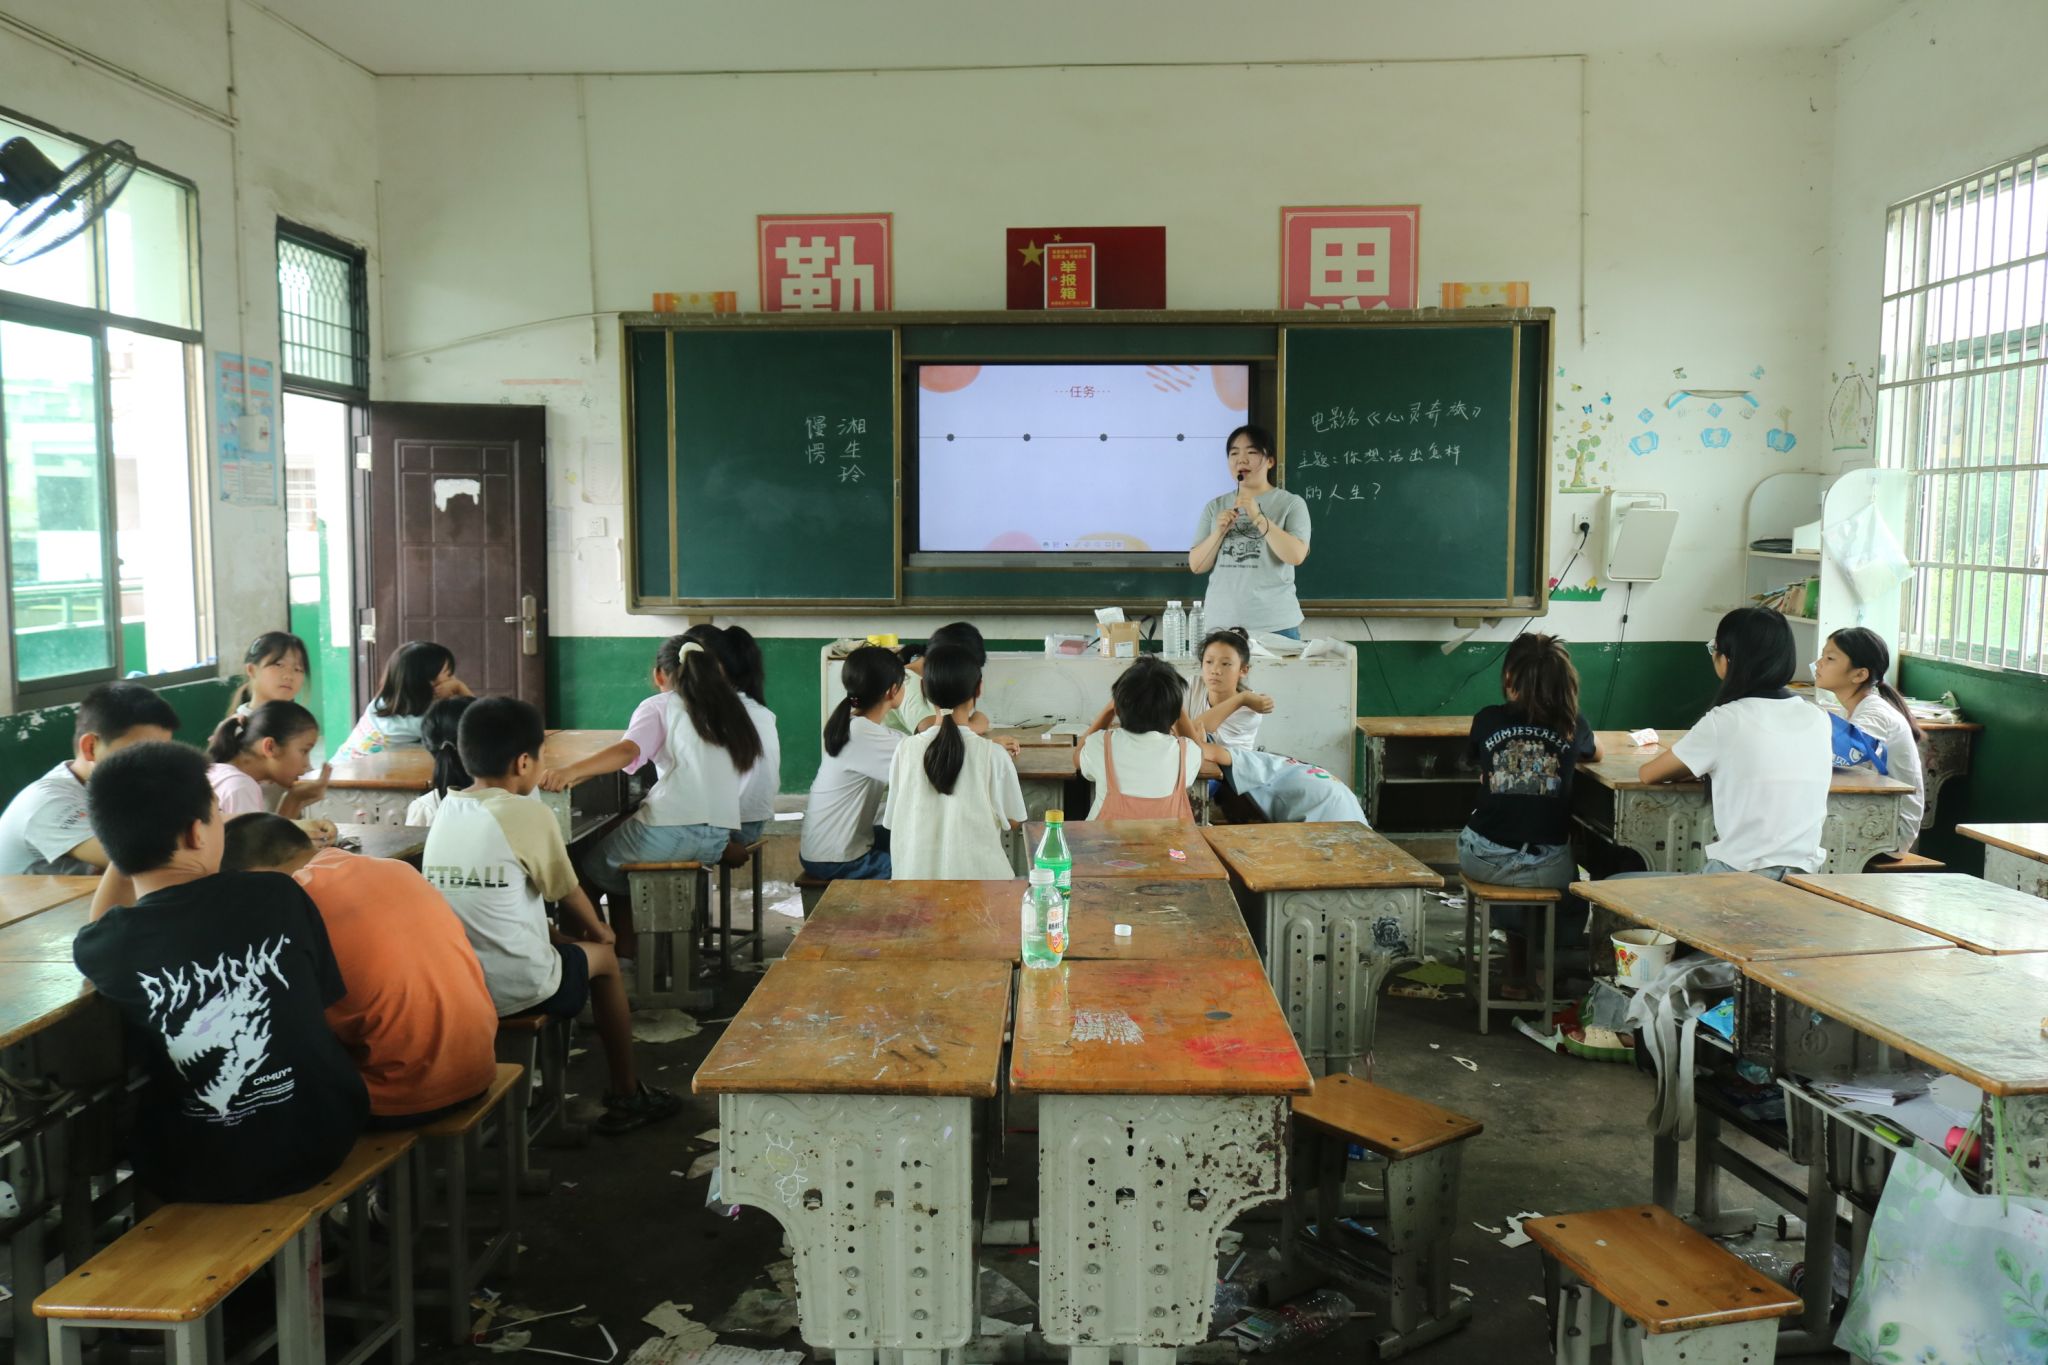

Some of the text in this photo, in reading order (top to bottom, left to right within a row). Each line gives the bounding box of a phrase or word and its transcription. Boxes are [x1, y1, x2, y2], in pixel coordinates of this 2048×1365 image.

[775, 236, 874, 311] 勤
[1060, 260, 1078, 300] 举报箱
[1069, 386, 1095, 399] 任务
[423, 865, 509, 889] ETBALL
